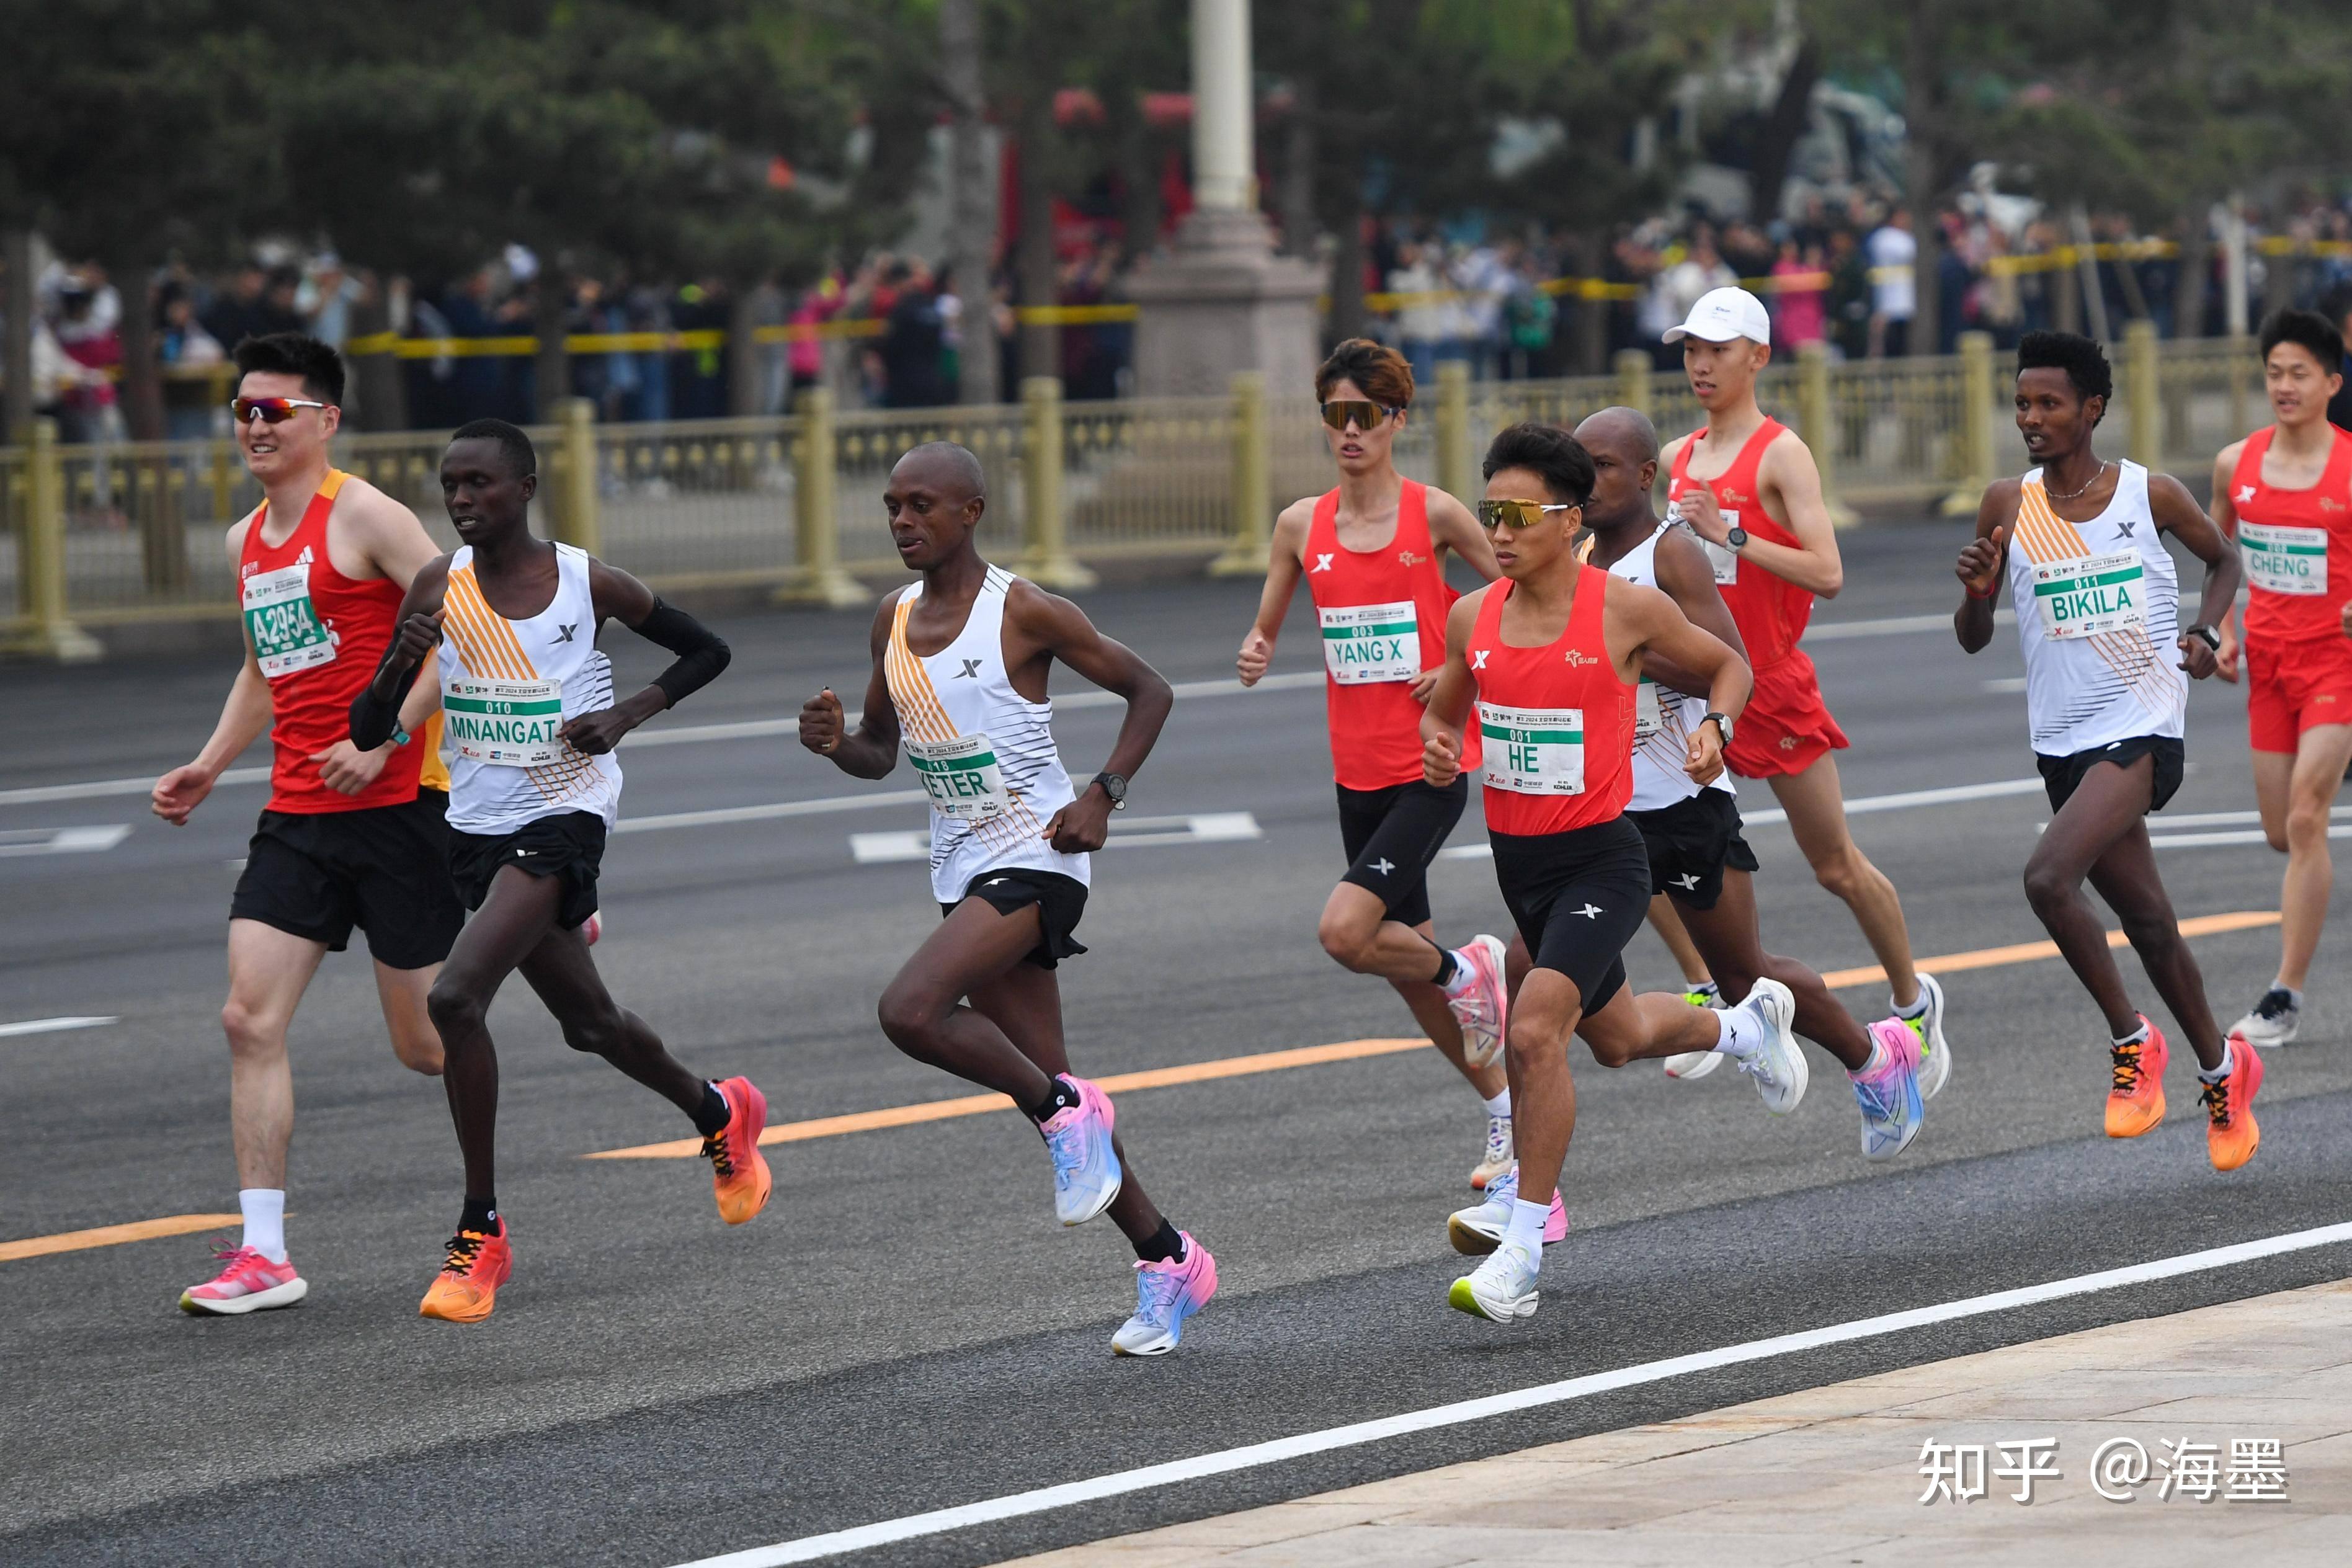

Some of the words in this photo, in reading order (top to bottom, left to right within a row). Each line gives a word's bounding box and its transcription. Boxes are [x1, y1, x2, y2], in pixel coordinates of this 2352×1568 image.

[2252, 553, 2309, 576] CHENG
[2074, 576, 2099, 590] 011
[2052, 586, 2132, 620] BIKILA
[253, 600, 314, 647] A2954
[1352, 625, 1374, 637] 003
[1333, 640, 1384, 664] YANG
[1389, 638, 1403, 660] X
[486, 702, 512, 715] 010
[451, 716, 556, 744] MNANGAT
[1510, 729, 1531, 742] 001
[1508, 744, 1539, 773] HE
